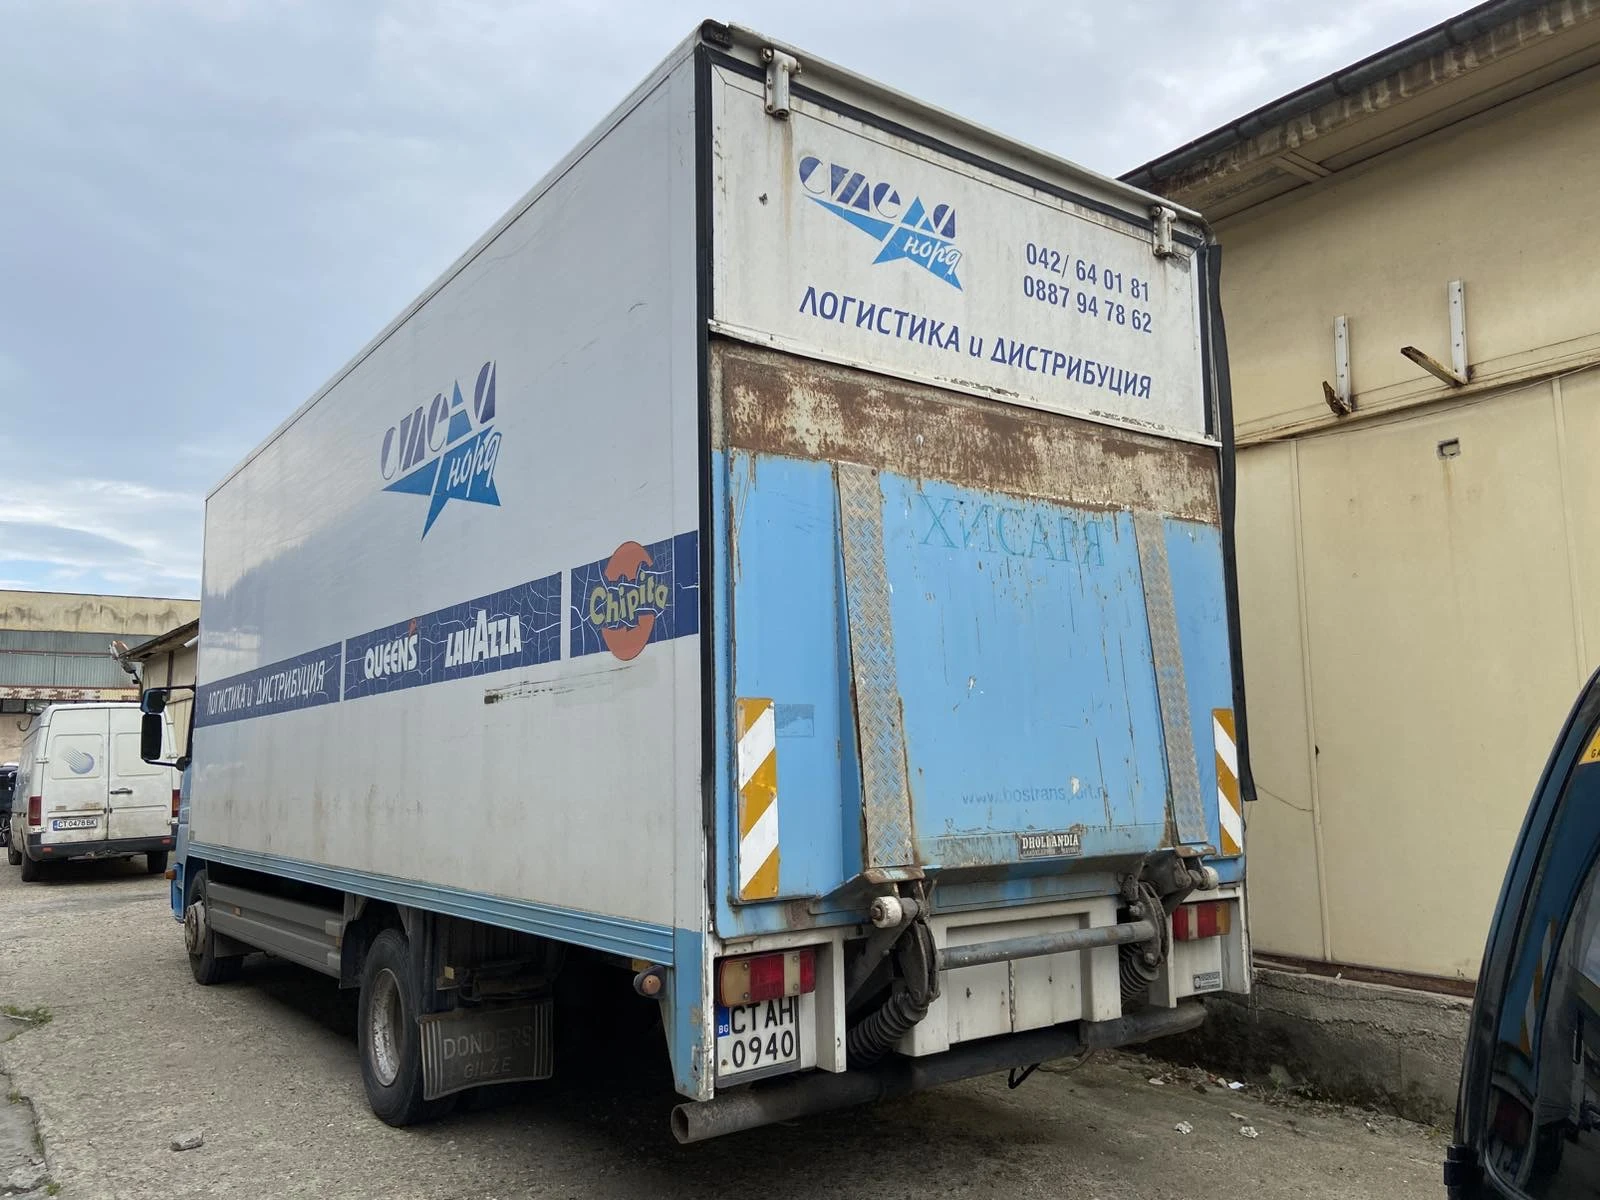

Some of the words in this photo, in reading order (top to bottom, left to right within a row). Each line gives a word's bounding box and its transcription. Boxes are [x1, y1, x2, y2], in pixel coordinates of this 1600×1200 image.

[1026, 243, 1069, 279] 042/
[1076, 259, 1097, 285] 64
[1103, 269, 1122, 293] 01
[1131, 278, 1149, 302] 81
[1023, 275, 1070, 308] 0887
[1076, 292, 1098, 317] 94
[1104, 300, 1125, 325] 78
[1131, 309, 1152, 333] 62
[799, 286, 961, 353] ЛОГИСТИКА
[990, 337, 1152, 399] ДИСТРИБУЦИЯ
[445, 610, 522, 668] LAVAZZA
[207, 684, 246, 716] ЛОГИСТИКА
[256, 660, 326, 706] ДИСТРИБУЦИЯ
[718, 1024, 729, 1034] BG
[732, 1030, 794, 1068] 0940
